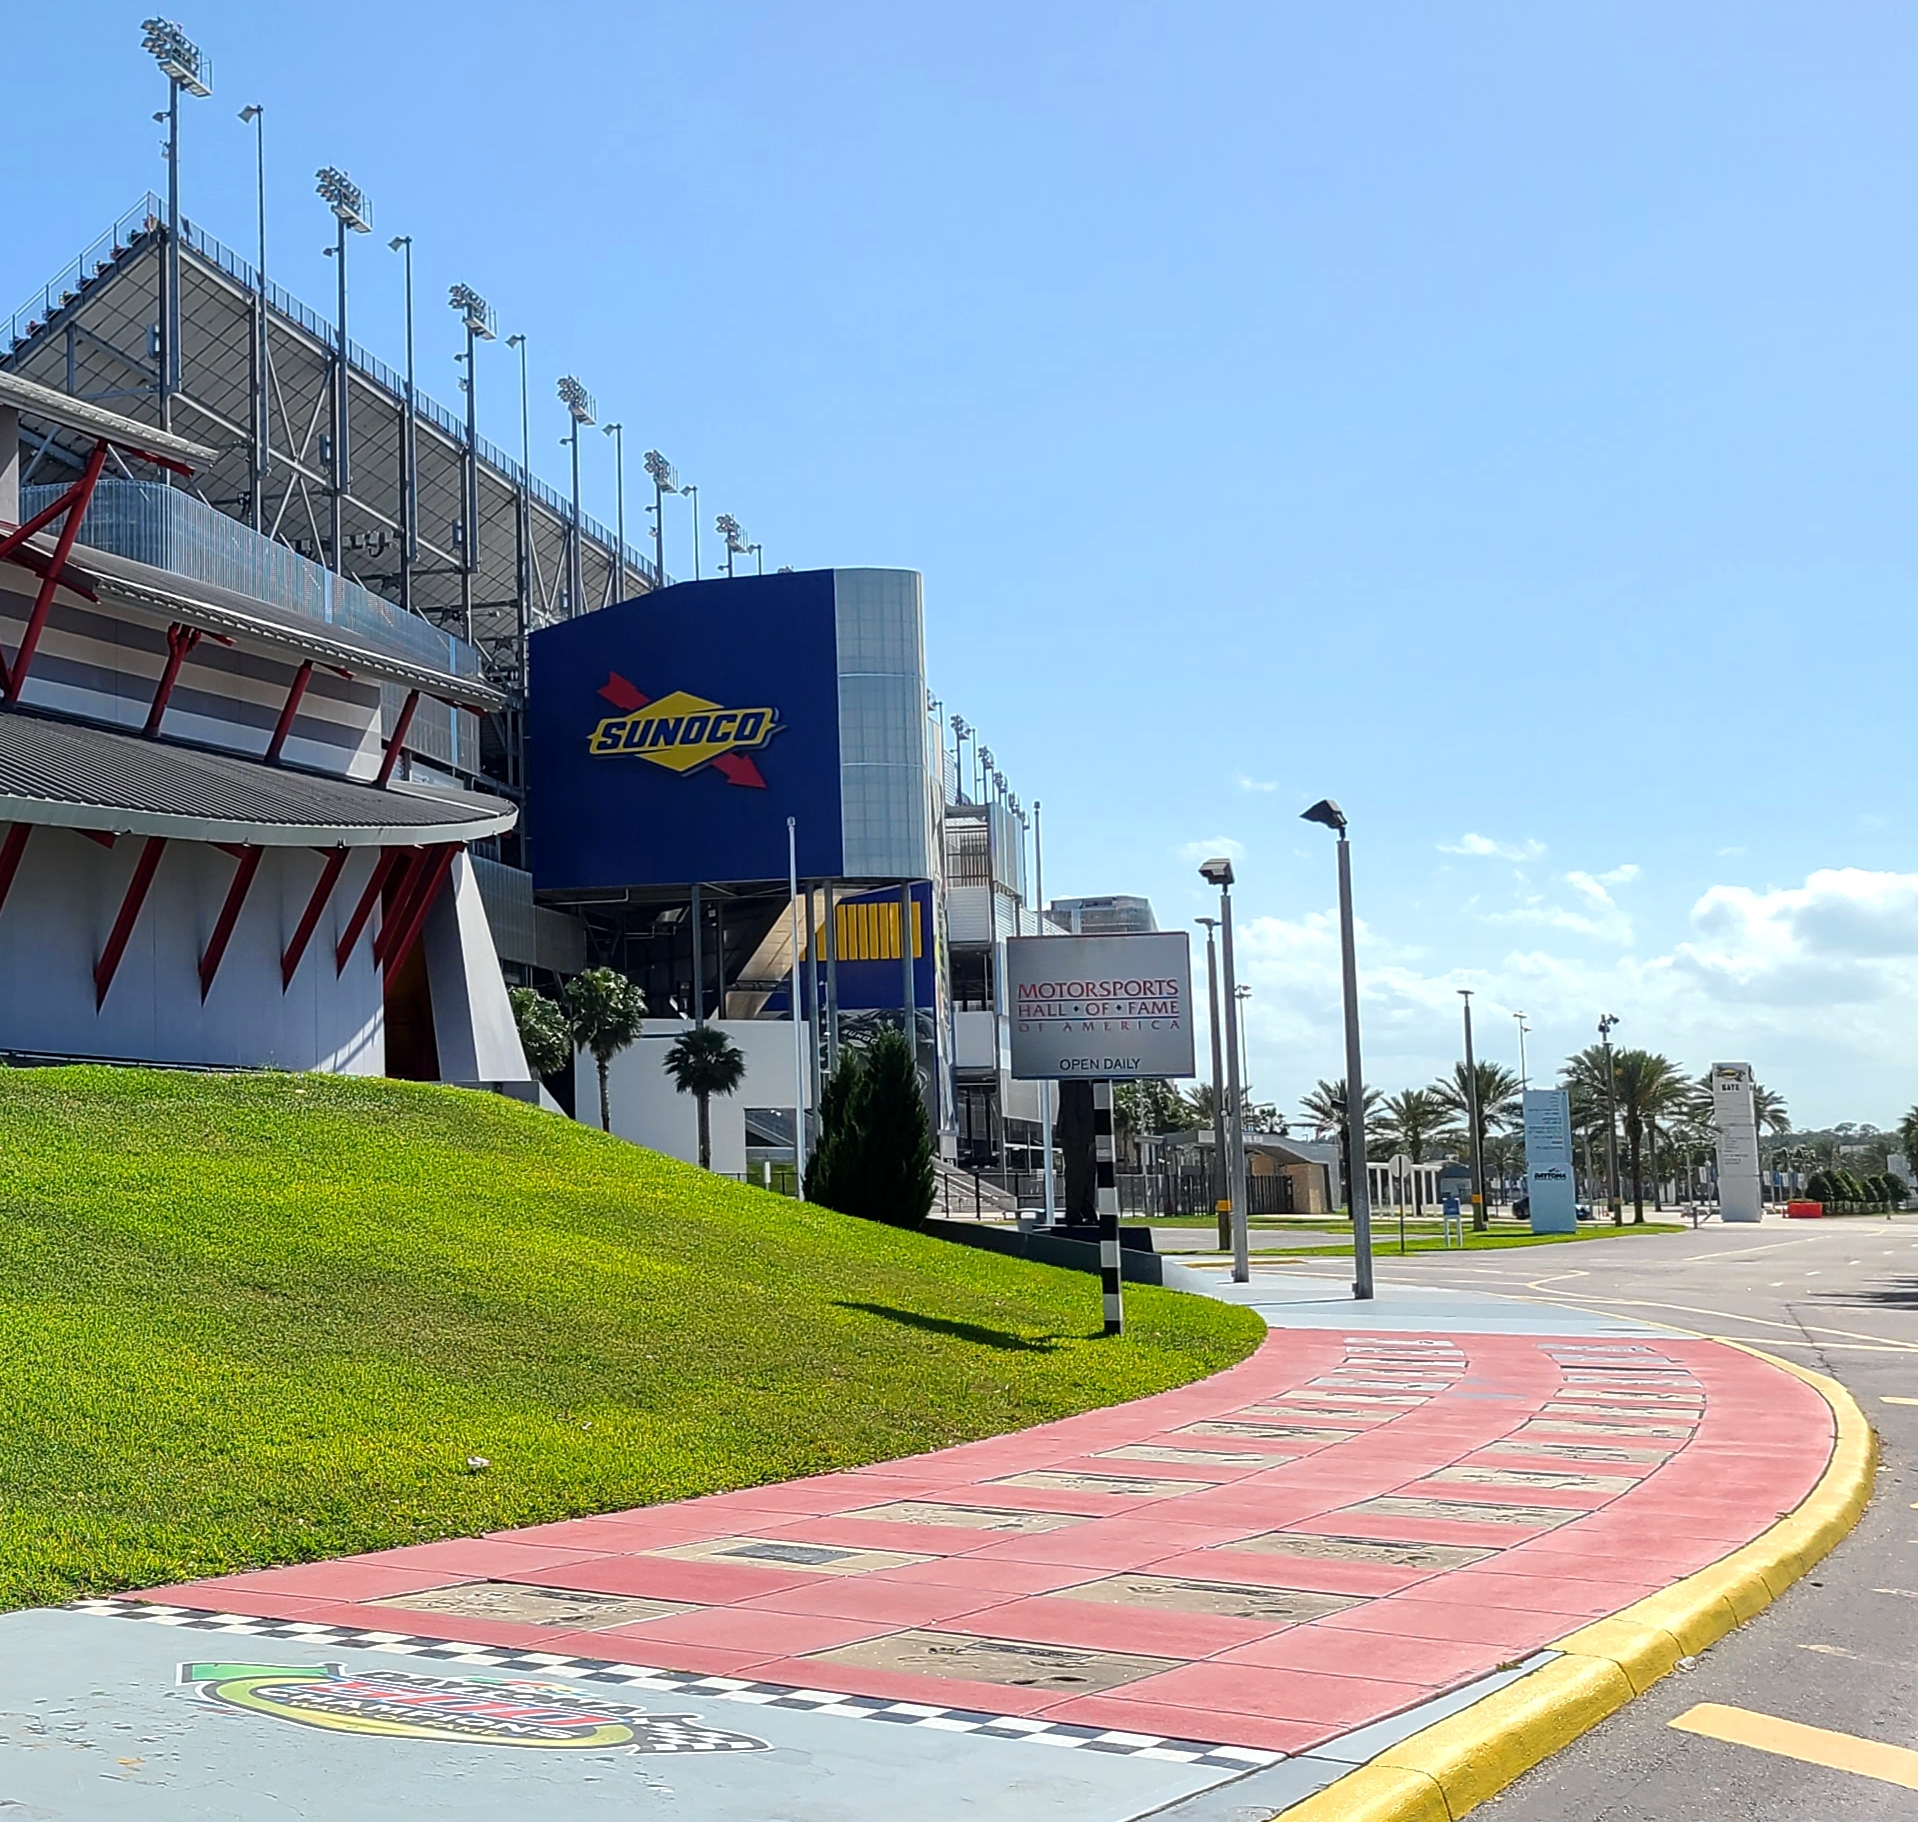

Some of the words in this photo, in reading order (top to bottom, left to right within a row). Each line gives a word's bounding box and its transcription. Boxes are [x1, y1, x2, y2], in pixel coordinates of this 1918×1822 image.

[596, 711, 767, 751] SUNOCO
[1018, 979, 1179, 999] MOTORSPORTS
[1018, 1003, 1067, 1017] HALL
[1085, 1002, 1109, 1016] OF
[1128, 1001, 1179, 1015] FAME
[1062, 1020, 1180, 1032] AMERICA
[1060, 1059, 1099, 1070] OPEN
[1104, 1058, 1141, 1070] DAILY
[1534, 1173, 1567, 1181] DAYTONA
[294, 1681, 624, 1727] 500
[354, 1671, 643, 1715] DAYTONA
[256, 1687, 581, 1739] CHAMPIONS
[289, 1701, 367, 1717] WALK
[375, 1714, 419, 1722] OF
[420, 1720, 505, 1737] FAME
